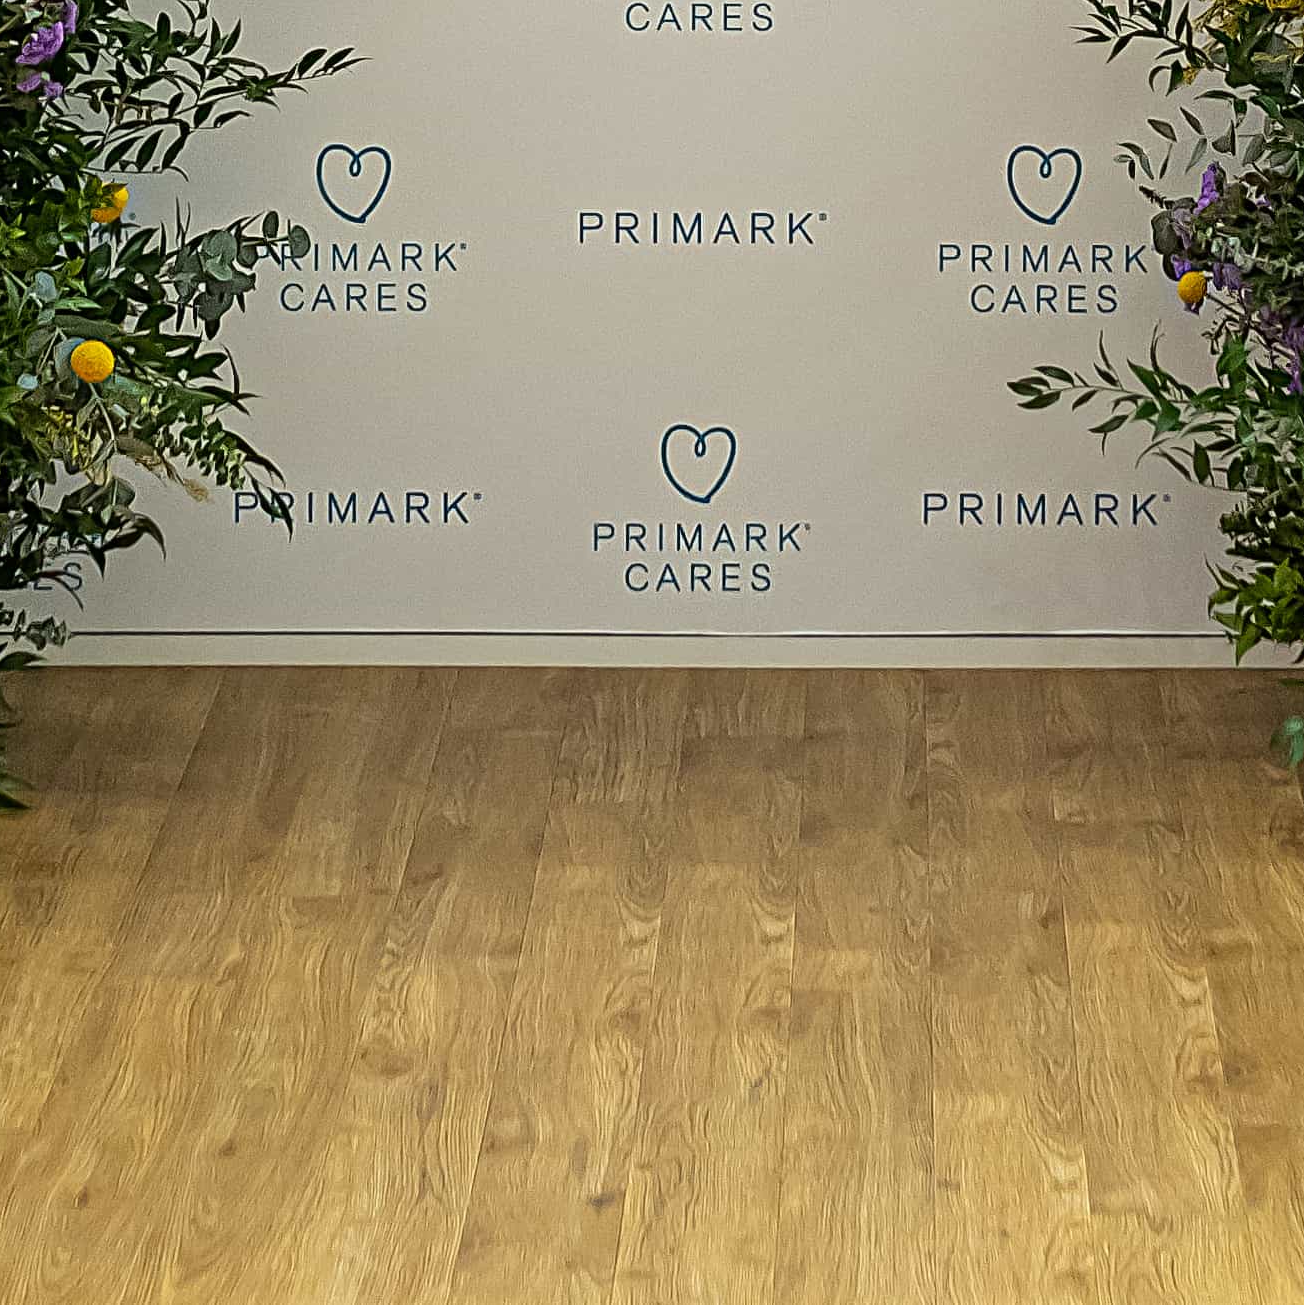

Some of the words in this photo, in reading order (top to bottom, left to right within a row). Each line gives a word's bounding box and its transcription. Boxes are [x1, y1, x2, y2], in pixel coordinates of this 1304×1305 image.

[626, 4, 773, 31] CARES
[280, 284, 427, 311] CARES
[971, 285, 1118, 313] CARES
[625, 564, 771, 591] CARES
